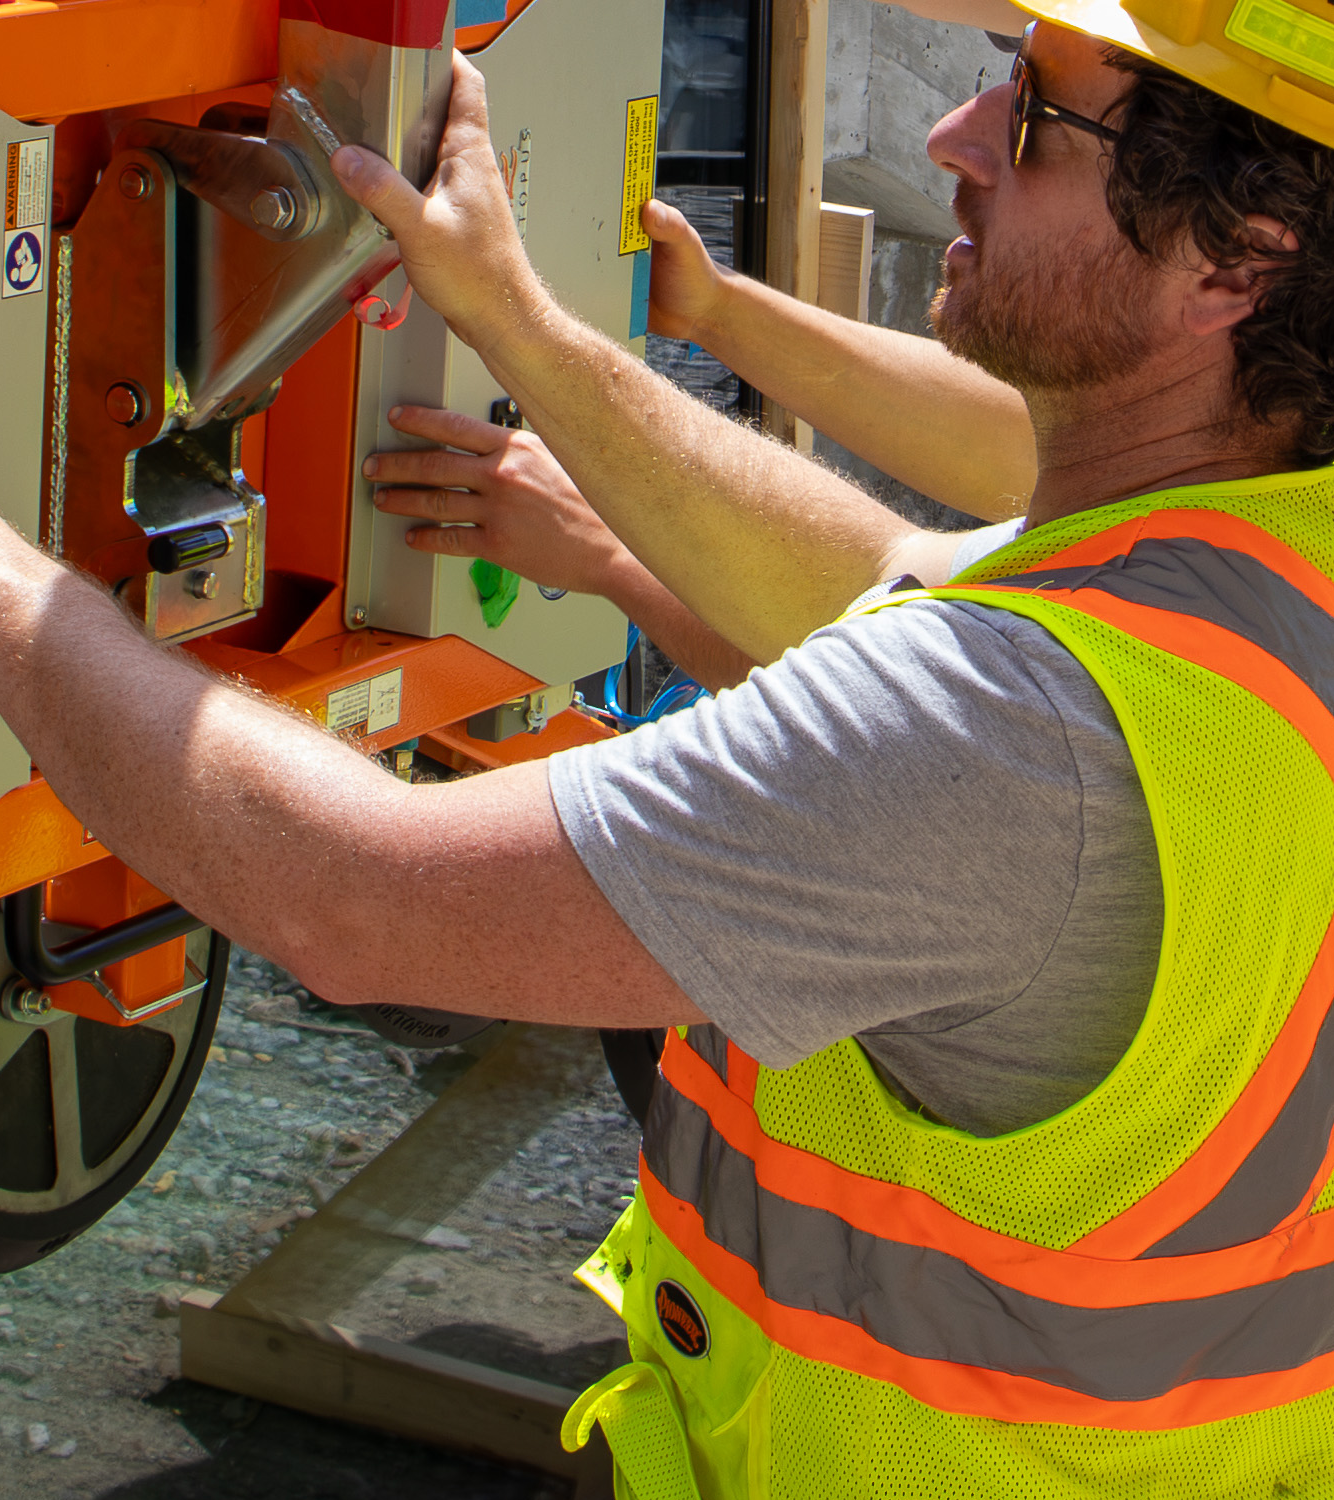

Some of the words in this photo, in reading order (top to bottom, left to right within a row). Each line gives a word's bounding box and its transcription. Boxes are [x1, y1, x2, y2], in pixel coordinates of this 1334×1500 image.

[7, 145, 16, 212] WARNING
[622, 209, 630, 249] Working
[657, 1286, 703, 1349] PIONEER
